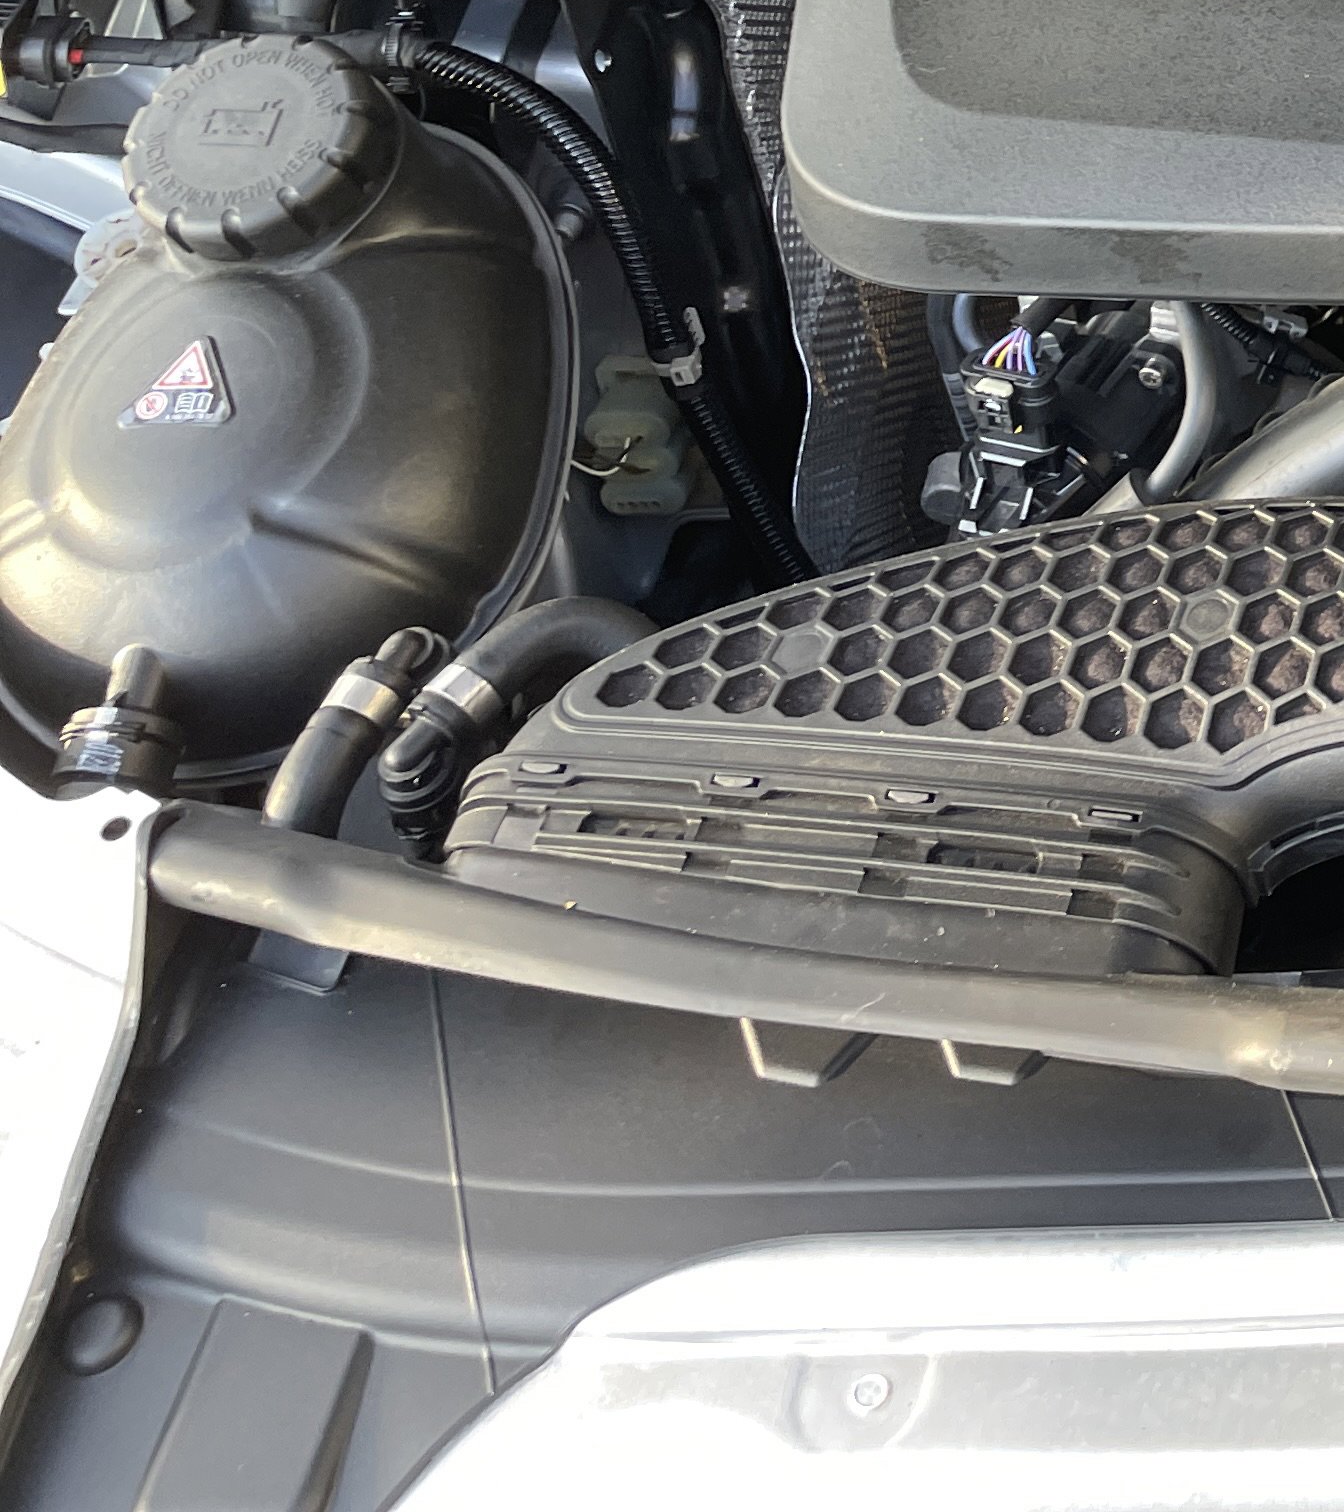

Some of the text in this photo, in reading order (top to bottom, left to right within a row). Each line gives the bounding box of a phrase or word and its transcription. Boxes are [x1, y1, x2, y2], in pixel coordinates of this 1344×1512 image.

[190, 60, 225, 89] NOT
[232, 49, 282, 68] OPEN
[285, 51, 328, 89] WHEN
[222, 176, 277, 207] WENN
